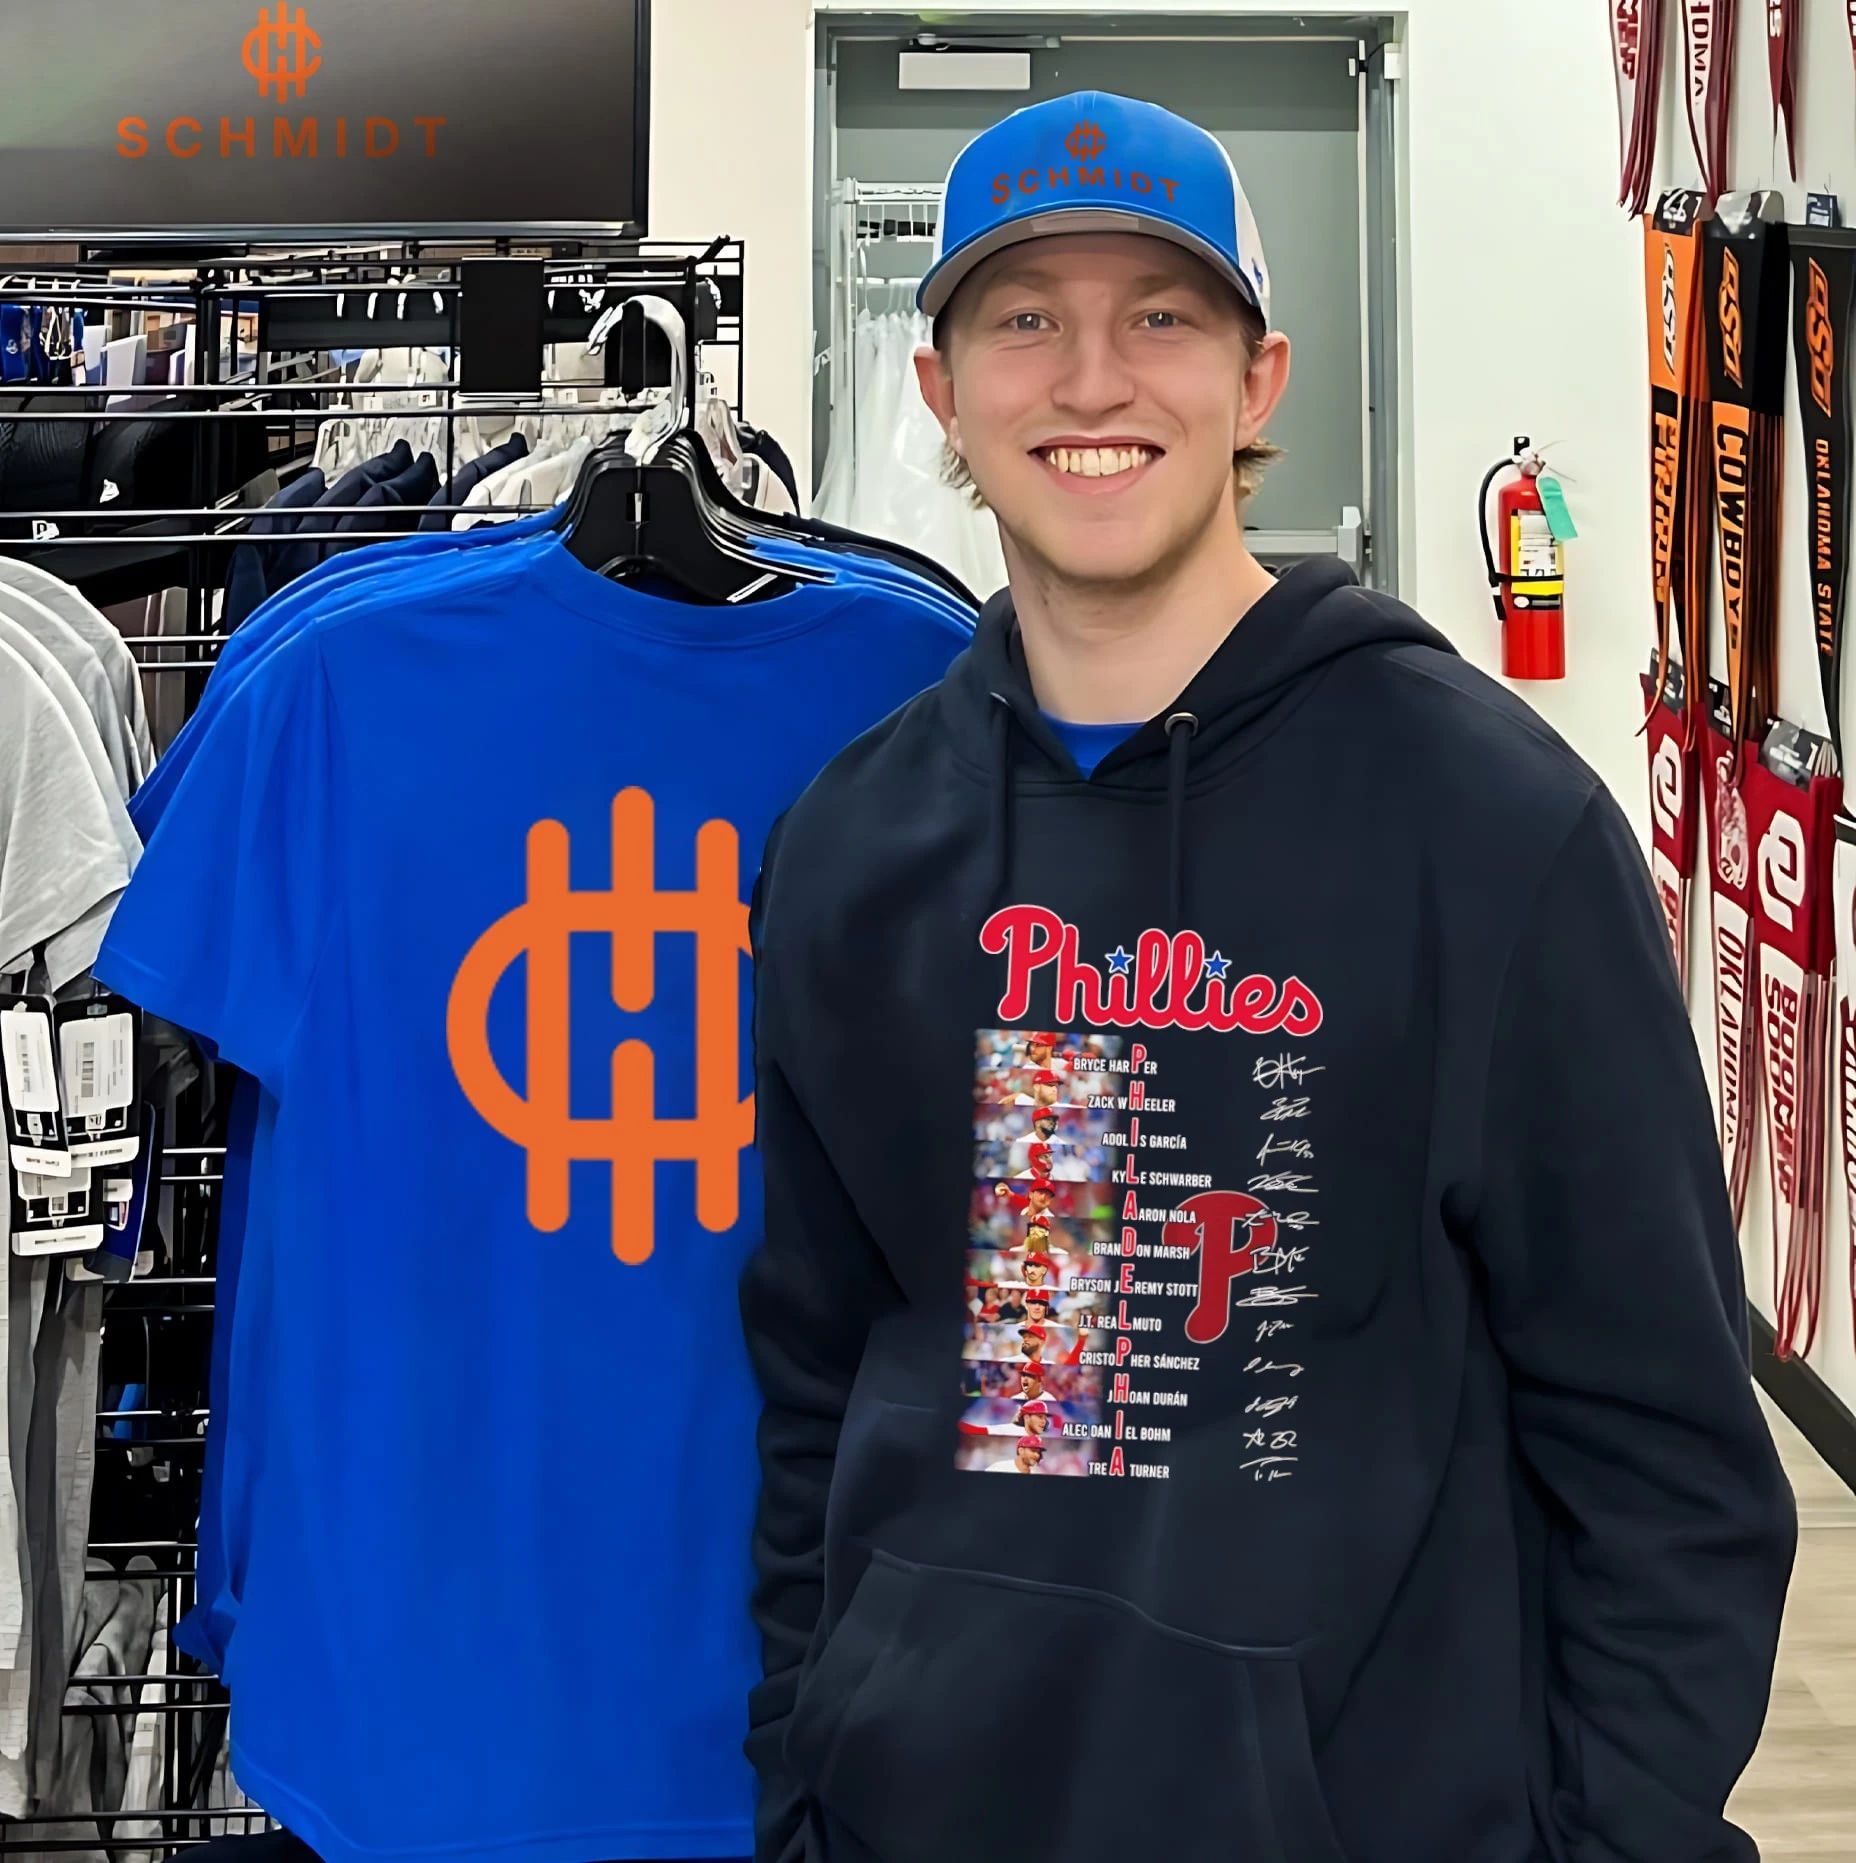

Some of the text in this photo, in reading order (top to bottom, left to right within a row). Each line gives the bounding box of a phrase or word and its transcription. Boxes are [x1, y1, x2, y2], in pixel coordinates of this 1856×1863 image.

[117, 117, 447, 158] SCHMIDT
[992, 166, 1179, 205] SCHMIDT
[1816, 438, 1832, 570] OKLAHOMA
[979, 904, 1323, 1036] Phillies
[1073, 1058, 1106, 1072] BRYCE
[1088, 1095, 1115, 1109] ZACK
[1149, 1134, 1187, 1150] GARCÍA
[1149, 1171, 1212, 1188] SCHWARBER
[1169, 1209, 1197, 1224] NOLA
[1153, 1245, 1190, 1260] MARSH
[1070, 1277, 1112, 1292] BRYSON
[1166, 1283, 1199, 1298] STOTT
[1078, 1315, 1095, 1329] J.T.
[1153, 1353, 1200, 1371] SÁNCHEZ
[1152, 1390, 1188, 1407] DURÁN
[1062, 1423, 1088, 1437] ALEC
[1140, 1427, 1171, 1442] BOHM
[1130, 1464, 1170, 1479] TURNER
